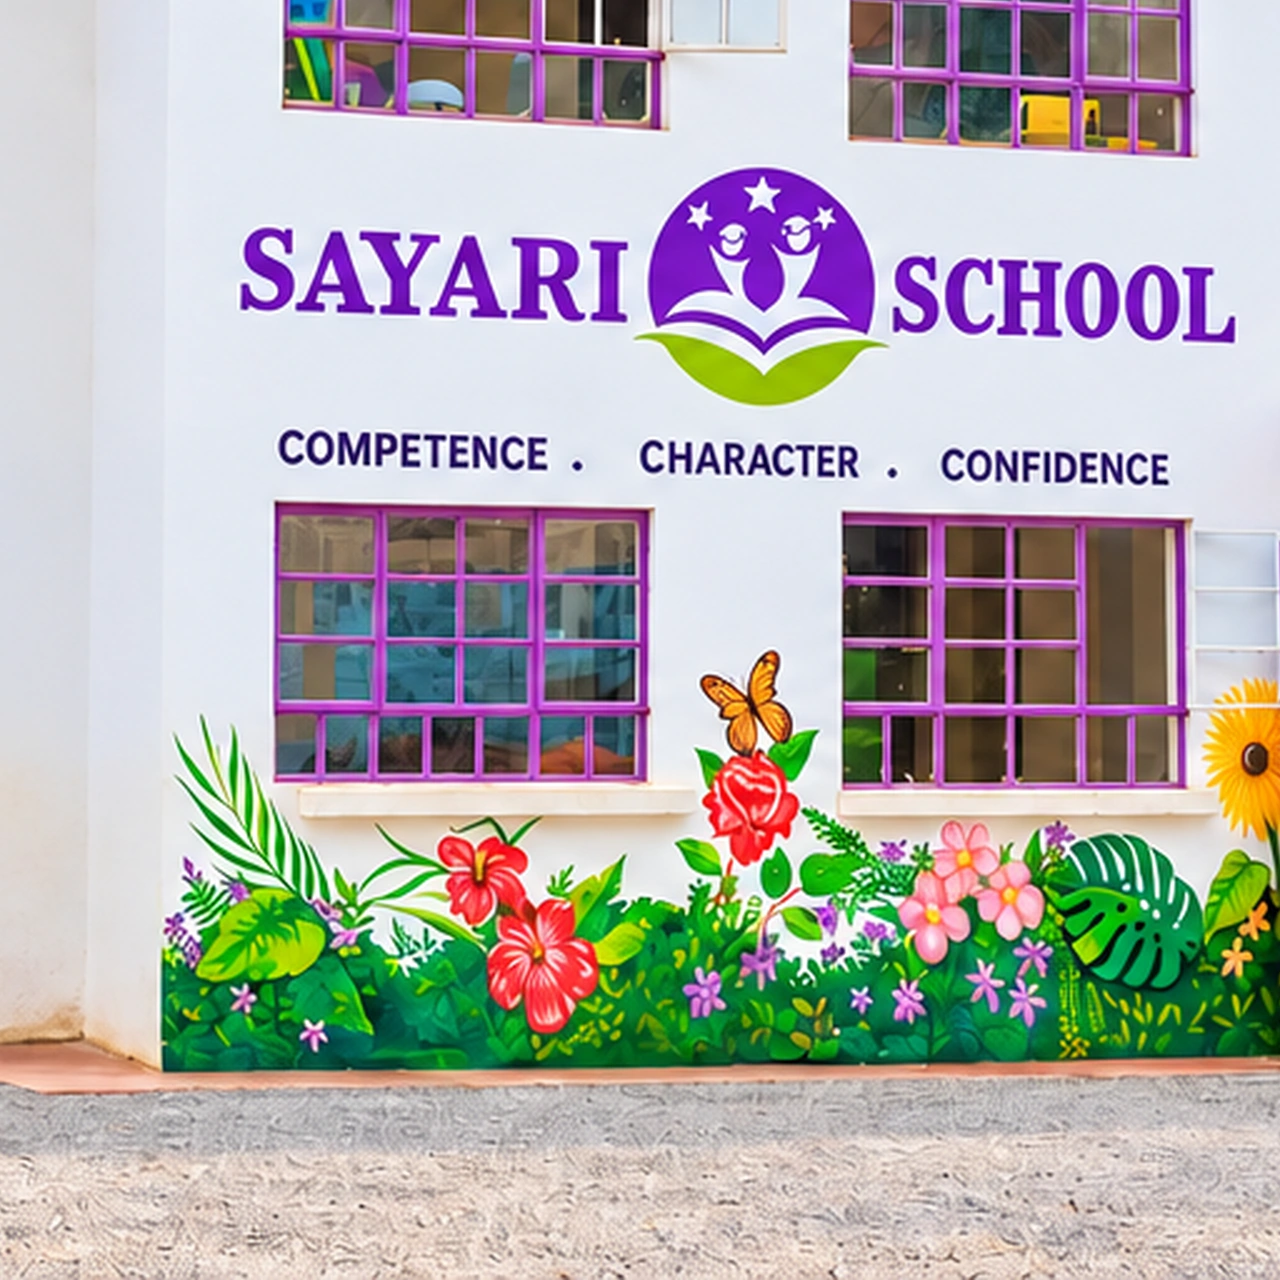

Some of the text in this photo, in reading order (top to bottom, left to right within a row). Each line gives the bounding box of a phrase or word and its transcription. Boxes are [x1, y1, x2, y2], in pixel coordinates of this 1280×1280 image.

[240, 227, 1236, 344] SAYARI SCHOOL
[278, 429, 548, 471] COMPETENCE
[640, 440, 859, 478] CHARACTER
[941, 448, 1169, 485] CONFIDENCE
